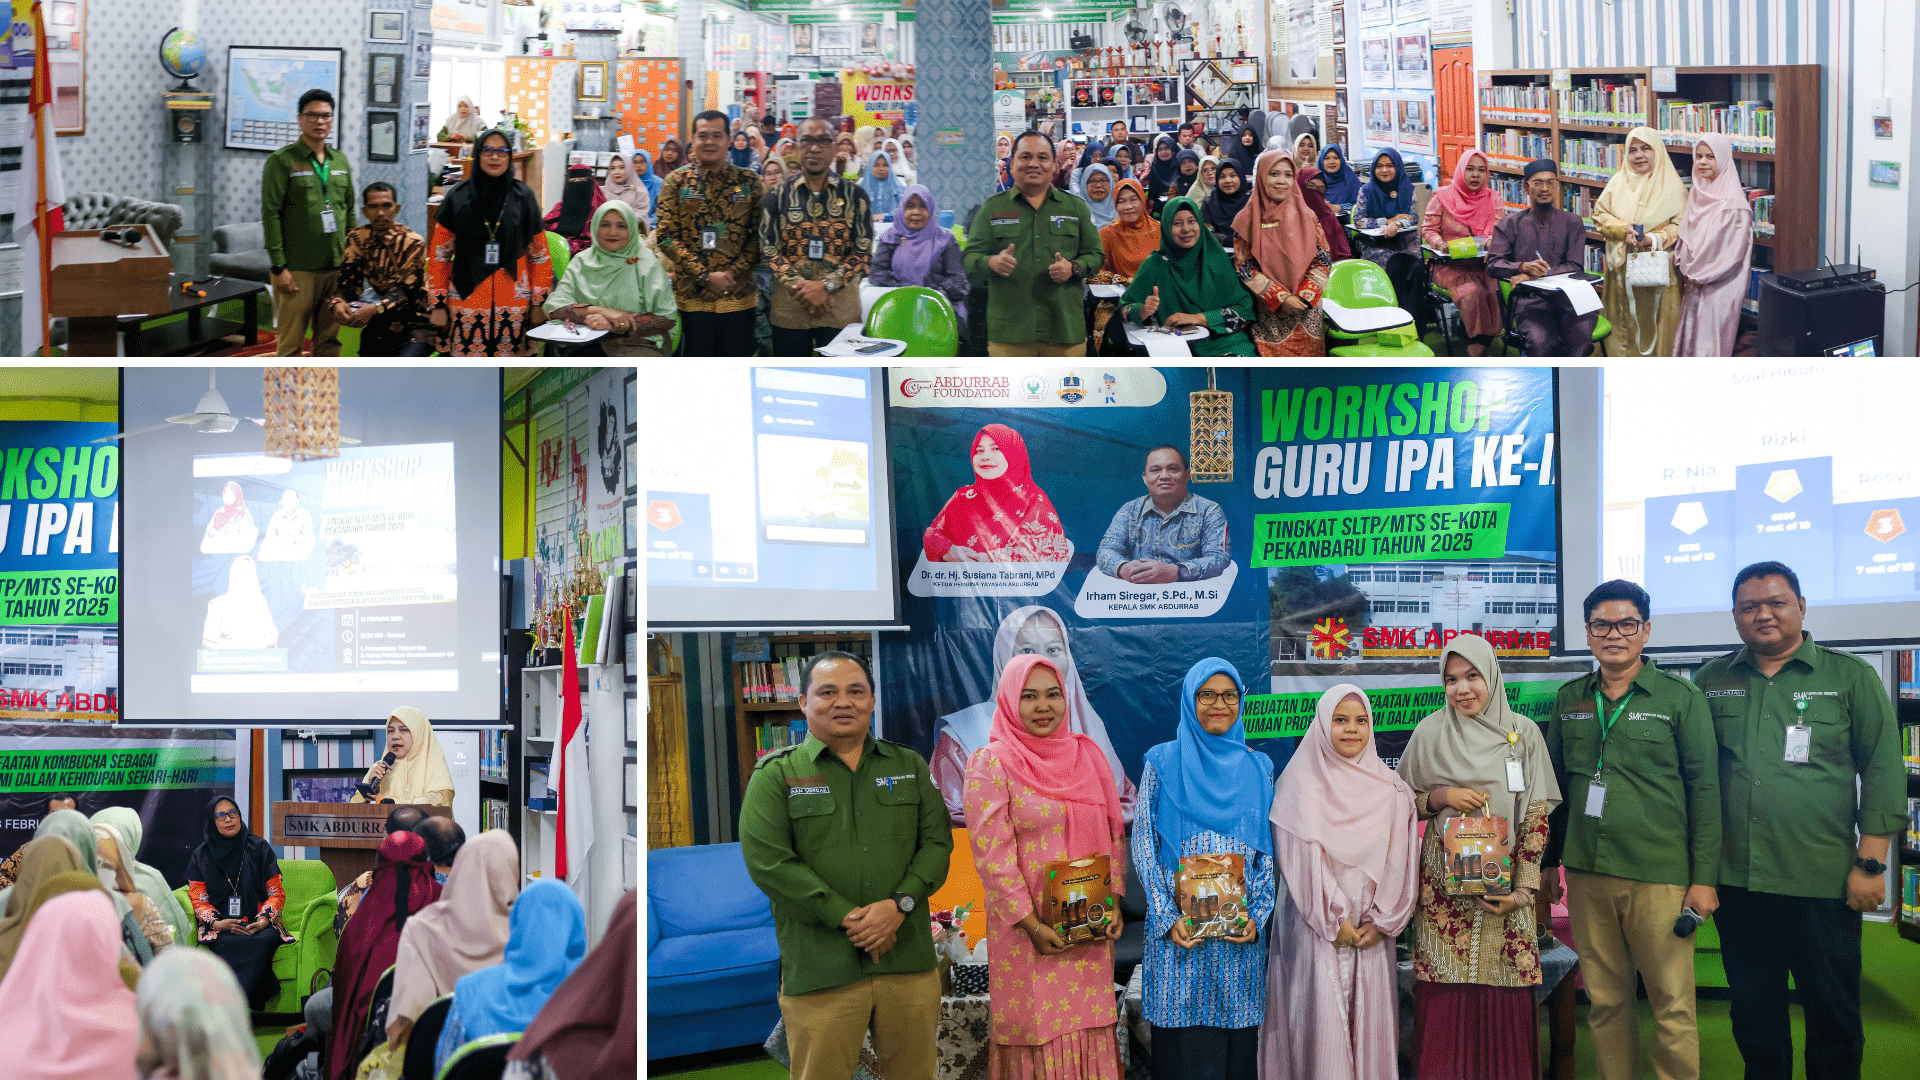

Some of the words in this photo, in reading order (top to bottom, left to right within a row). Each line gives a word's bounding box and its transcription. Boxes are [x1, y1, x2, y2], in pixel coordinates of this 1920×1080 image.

[934, 376, 1010, 388] ABDURRAB
[934, 388, 1010, 398] FOUNDATION
[1261, 379, 1508, 443] WORKSHOP
[1762, 430, 1805, 447] Rizki
[0, 445, 118, 500] KSHO
[326, 454, 420, 486] WORKSHOP
[1253, 441, 1372, 500] GURU
[1384, 438, 1455, 493] IPA
[1663, 468, 1679, 481] R.
[1686, 464, 1716, 478] Nia
[1859, 468, 1911, 486] Resvi
[656, 508, 671, 523] 3
[21, 502, 94, 556] IPA
[365, 522, 387, 532] TAHUN
[387, 521, 405, 531] 2025
[1266, 518, 1338, 539] TINGKAT
[1341, 513, 1426, 536] SLTP/MTS
[1430, 510, 1498, 532] SE-KOTA
[1765, 523, 1784, 533] out
[1785, 522, 1798, 531] of
[1799, 521, 1811, 530] 10
[1877, 517, 1893, 534] 3
[1263, 539, 1366, 561] PEKANBARU
[1371, 535, 1426, 556] TAHUN
[1430, 533, 1474, 552] 2025
[1672, 554, 1689, 563] out
[1690, 553, 1703, 562] of
[1703, 552, 1715, 561] 10
[921, 571, 933, 579] Dr.
[935, 571, 947, 579] dr.
[948, 571, 960, 581] Hj.
[962, 571, 997, 580] Susiana
[999, 571, 1034, 581] Tabrani,
[1036, 570, 1056, 579] MPd
[1865, 565, 1886, 574] out
[1887, 563, 1900, 573] of
[1901, 562, 1914, 572] 10
[1086, 591, 1117, 601] Irham
[1119, 591, 1160, 602] Siregar,
[1162, 590, 1192, 601] S.Pd.,
[1194, 590, 1218, 600] M.Si
[5, 599, 61, 618] TAHUN
[64, 598, 110, 617] 2025
[1362, 627, 1418, 648] SMK
[1793, 691, 1809, 701] SMK
[1628, 711, 1644, 721] SMK
[42, 754, 107, 770] KOMBUCHA
[110, 753, 158, 768] SEBAGAI
[15, 771, 56, 787] DALAM
[58, 770, 125, 787] KEHIDUPAN
[127, 768, 199, 785] SEHARI-HARI
[289, 820, 320, 833] SMK
